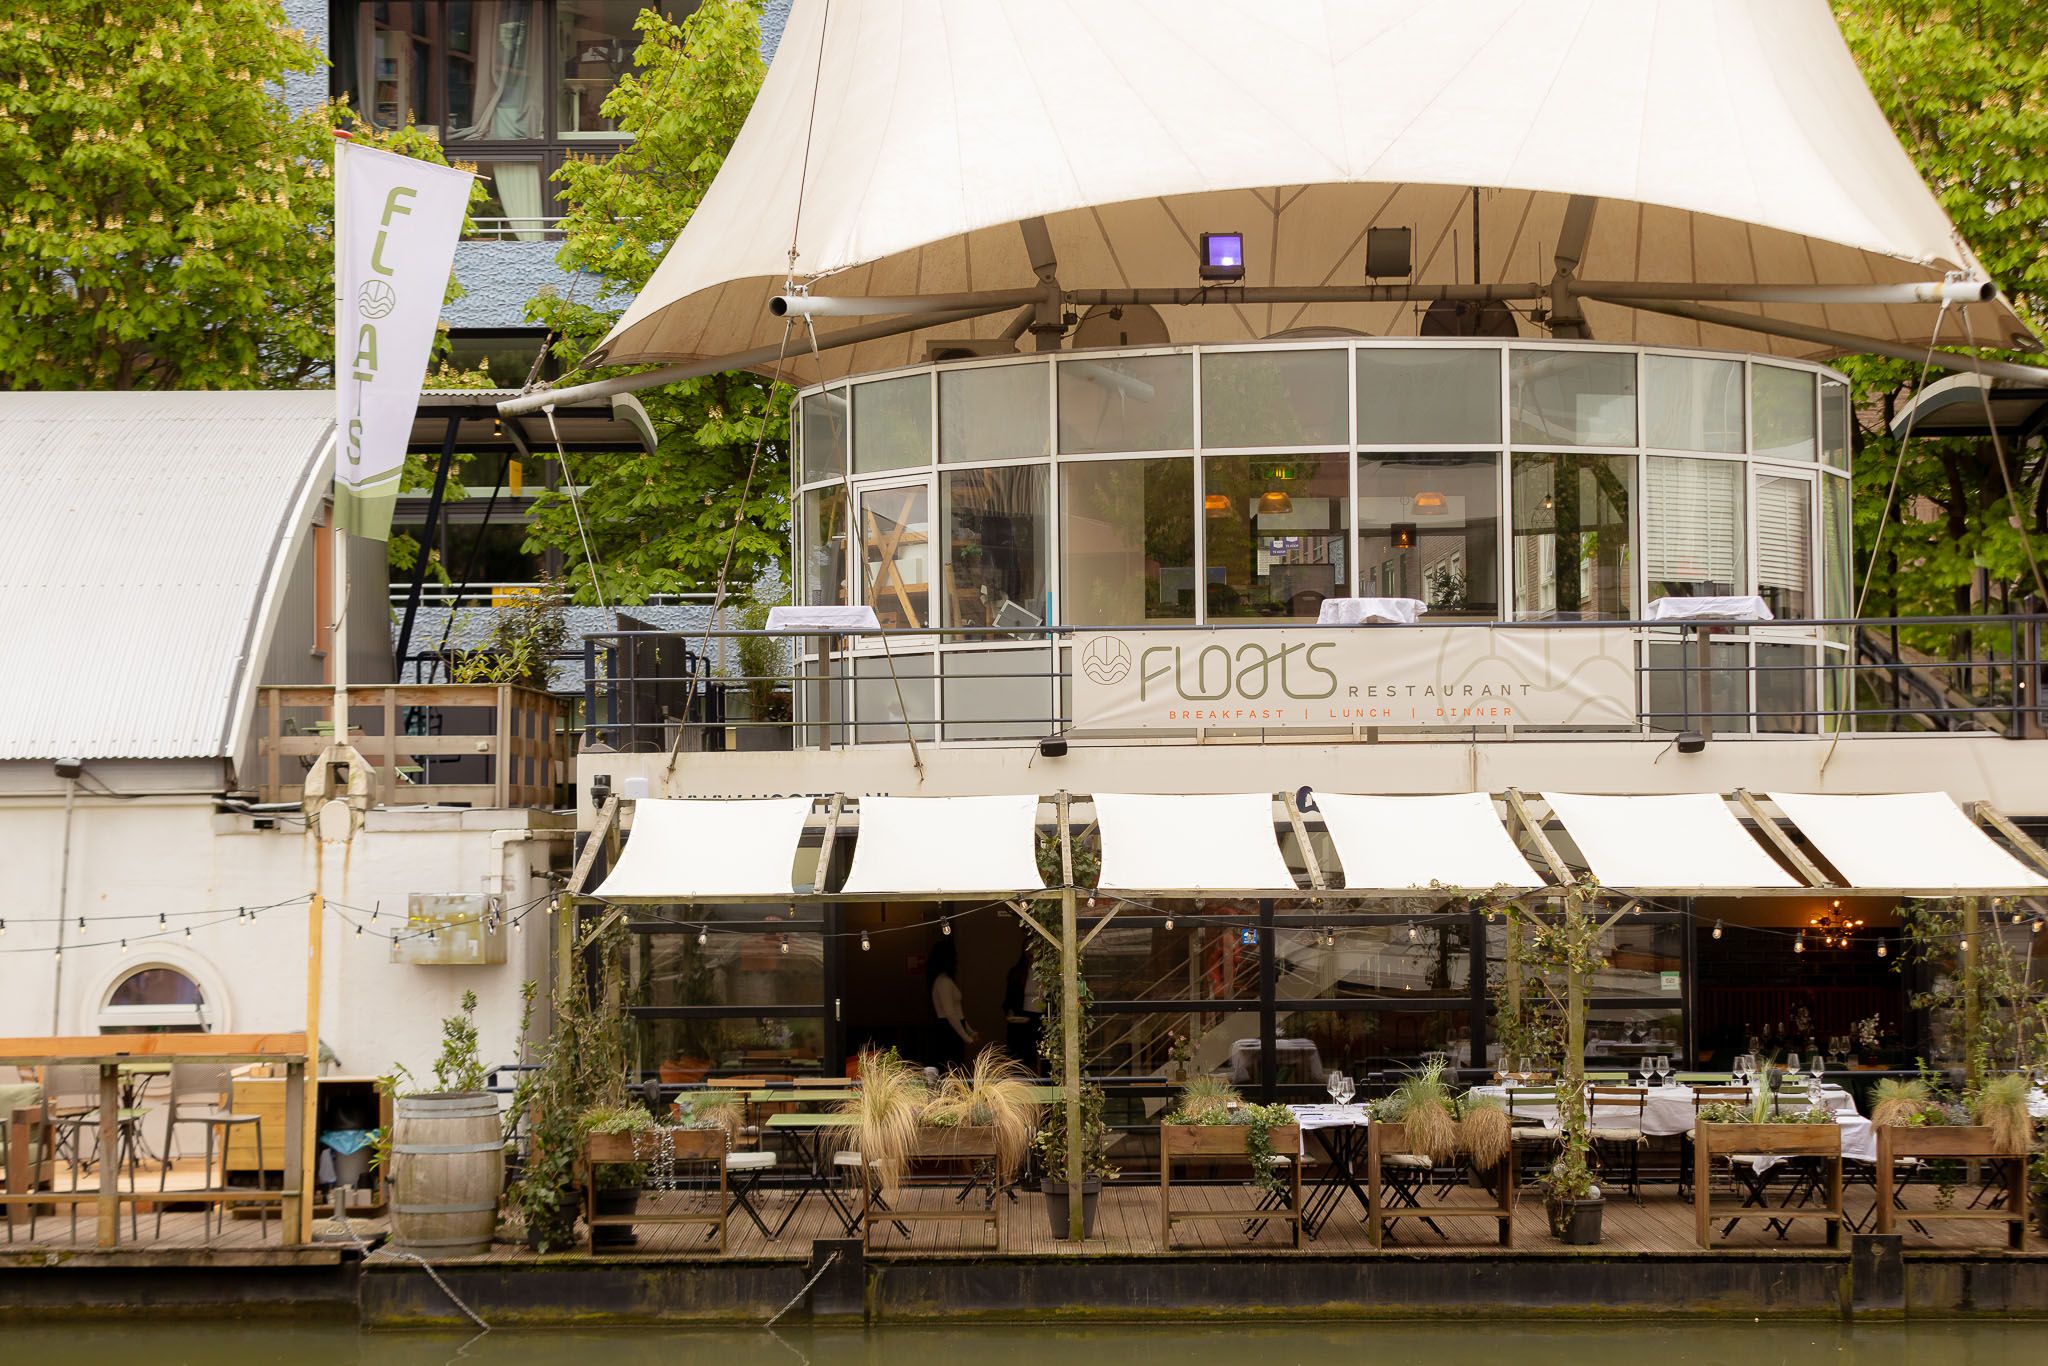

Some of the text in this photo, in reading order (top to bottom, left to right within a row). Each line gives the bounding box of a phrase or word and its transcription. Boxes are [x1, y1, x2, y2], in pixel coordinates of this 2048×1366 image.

[1348, 684, 1531, 698] RESTAURANT
[1169, 709, 1284, 720] BREAKFAST
[1329, 708, 1391, 719] LUNCH
[1436, 707, 1513, 718] DINNER
